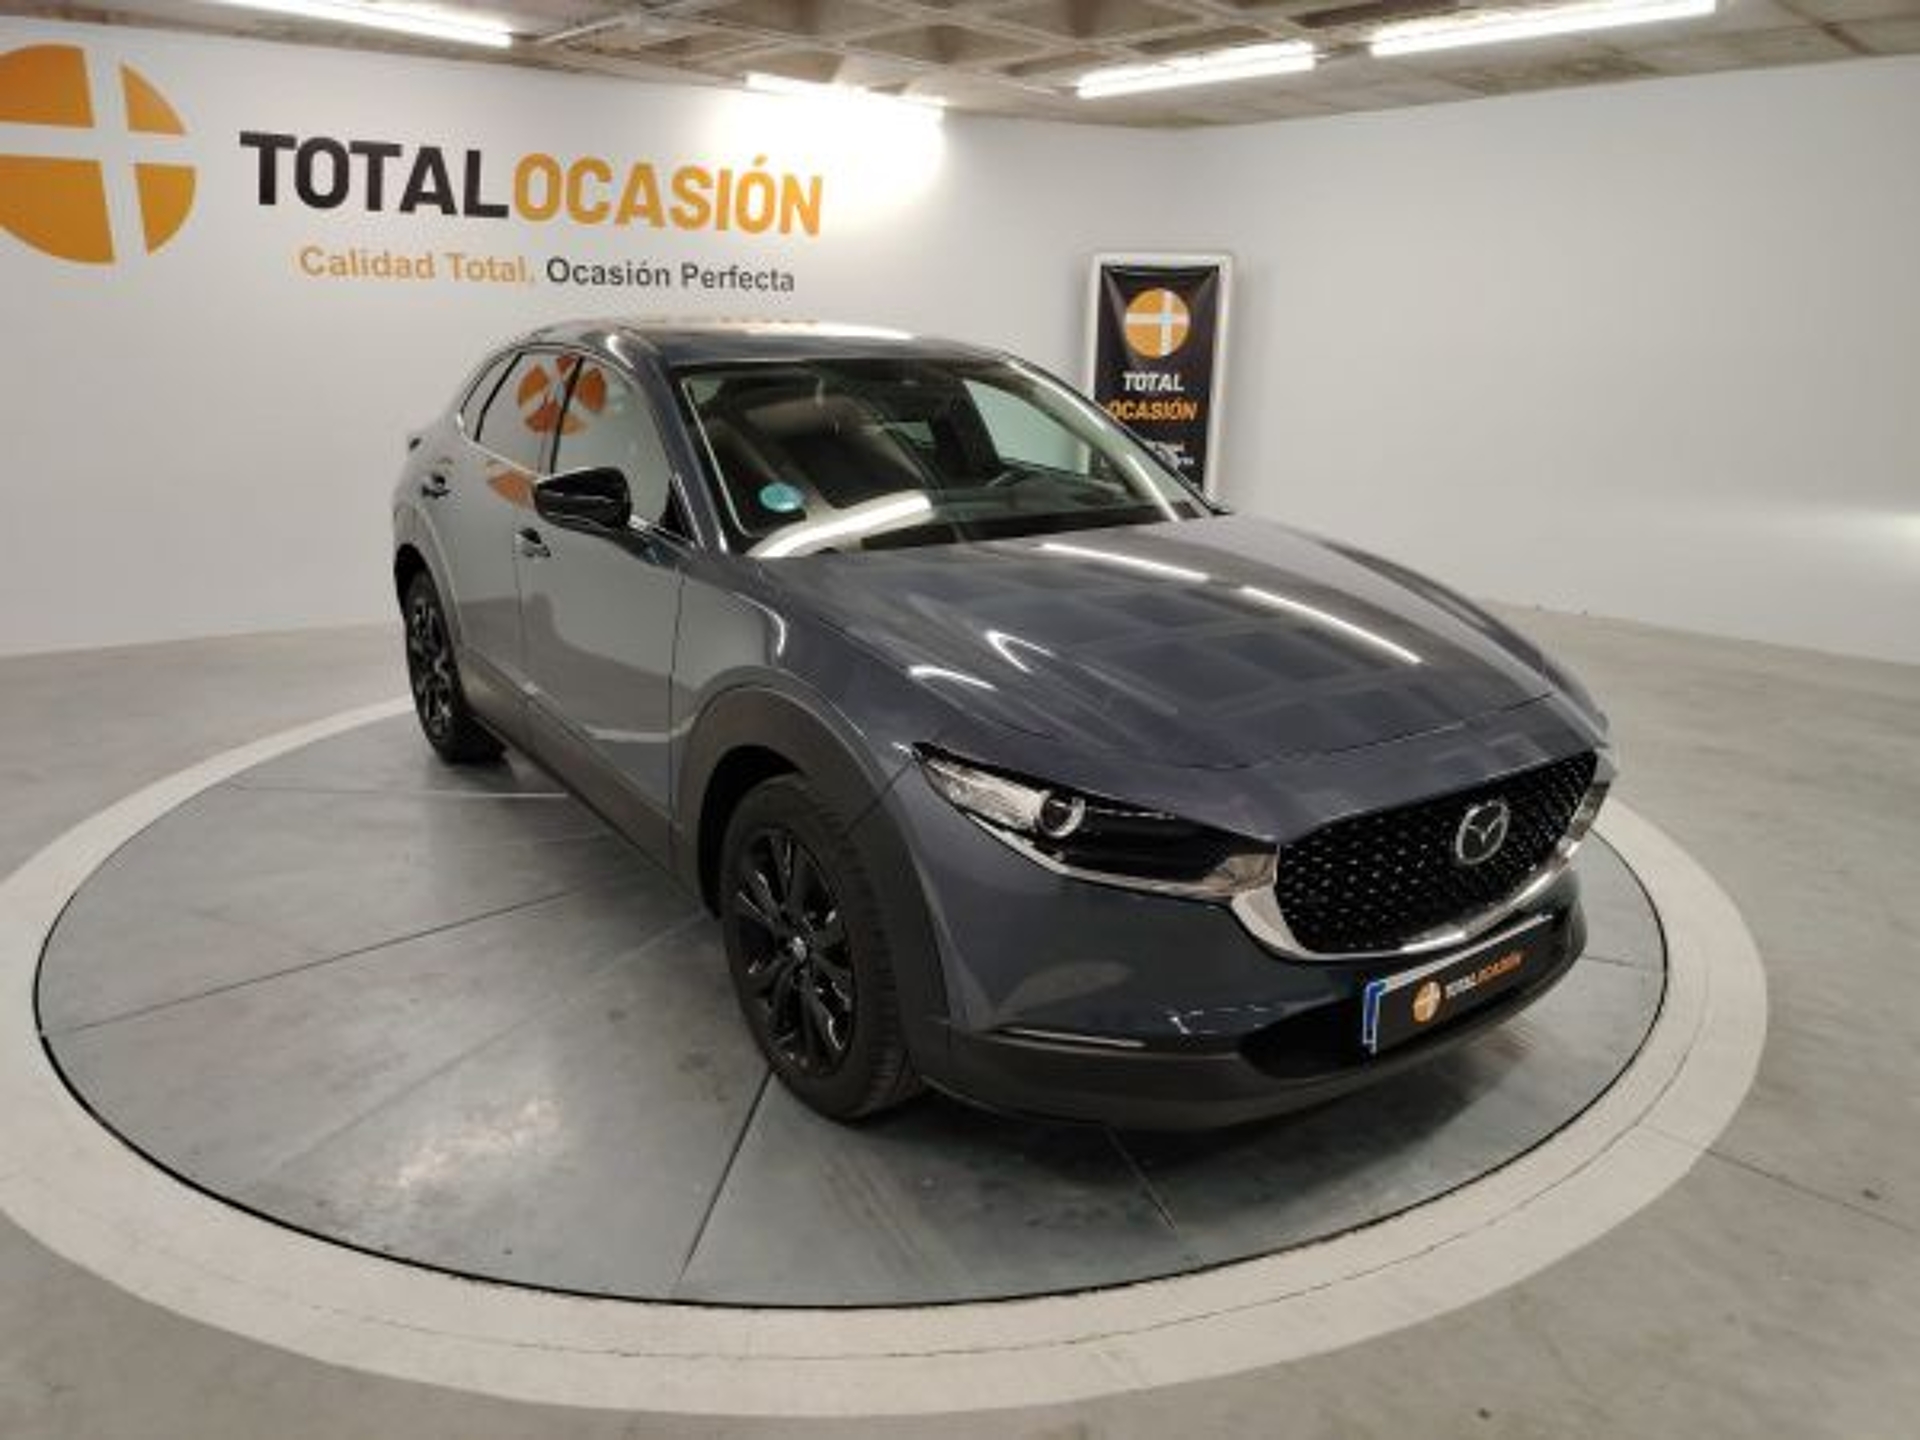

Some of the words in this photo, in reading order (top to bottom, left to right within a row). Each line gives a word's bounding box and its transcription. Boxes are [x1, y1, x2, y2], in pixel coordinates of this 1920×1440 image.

[299, 246, 435, 280] Calidad
[546, 257, 671, 287] Ocasión
[681, 262, 796, 292] Perfecta
[1122, 371, 1185, 392] TOTAL
[1108, 396, 1197, 420] OCASIÓN
